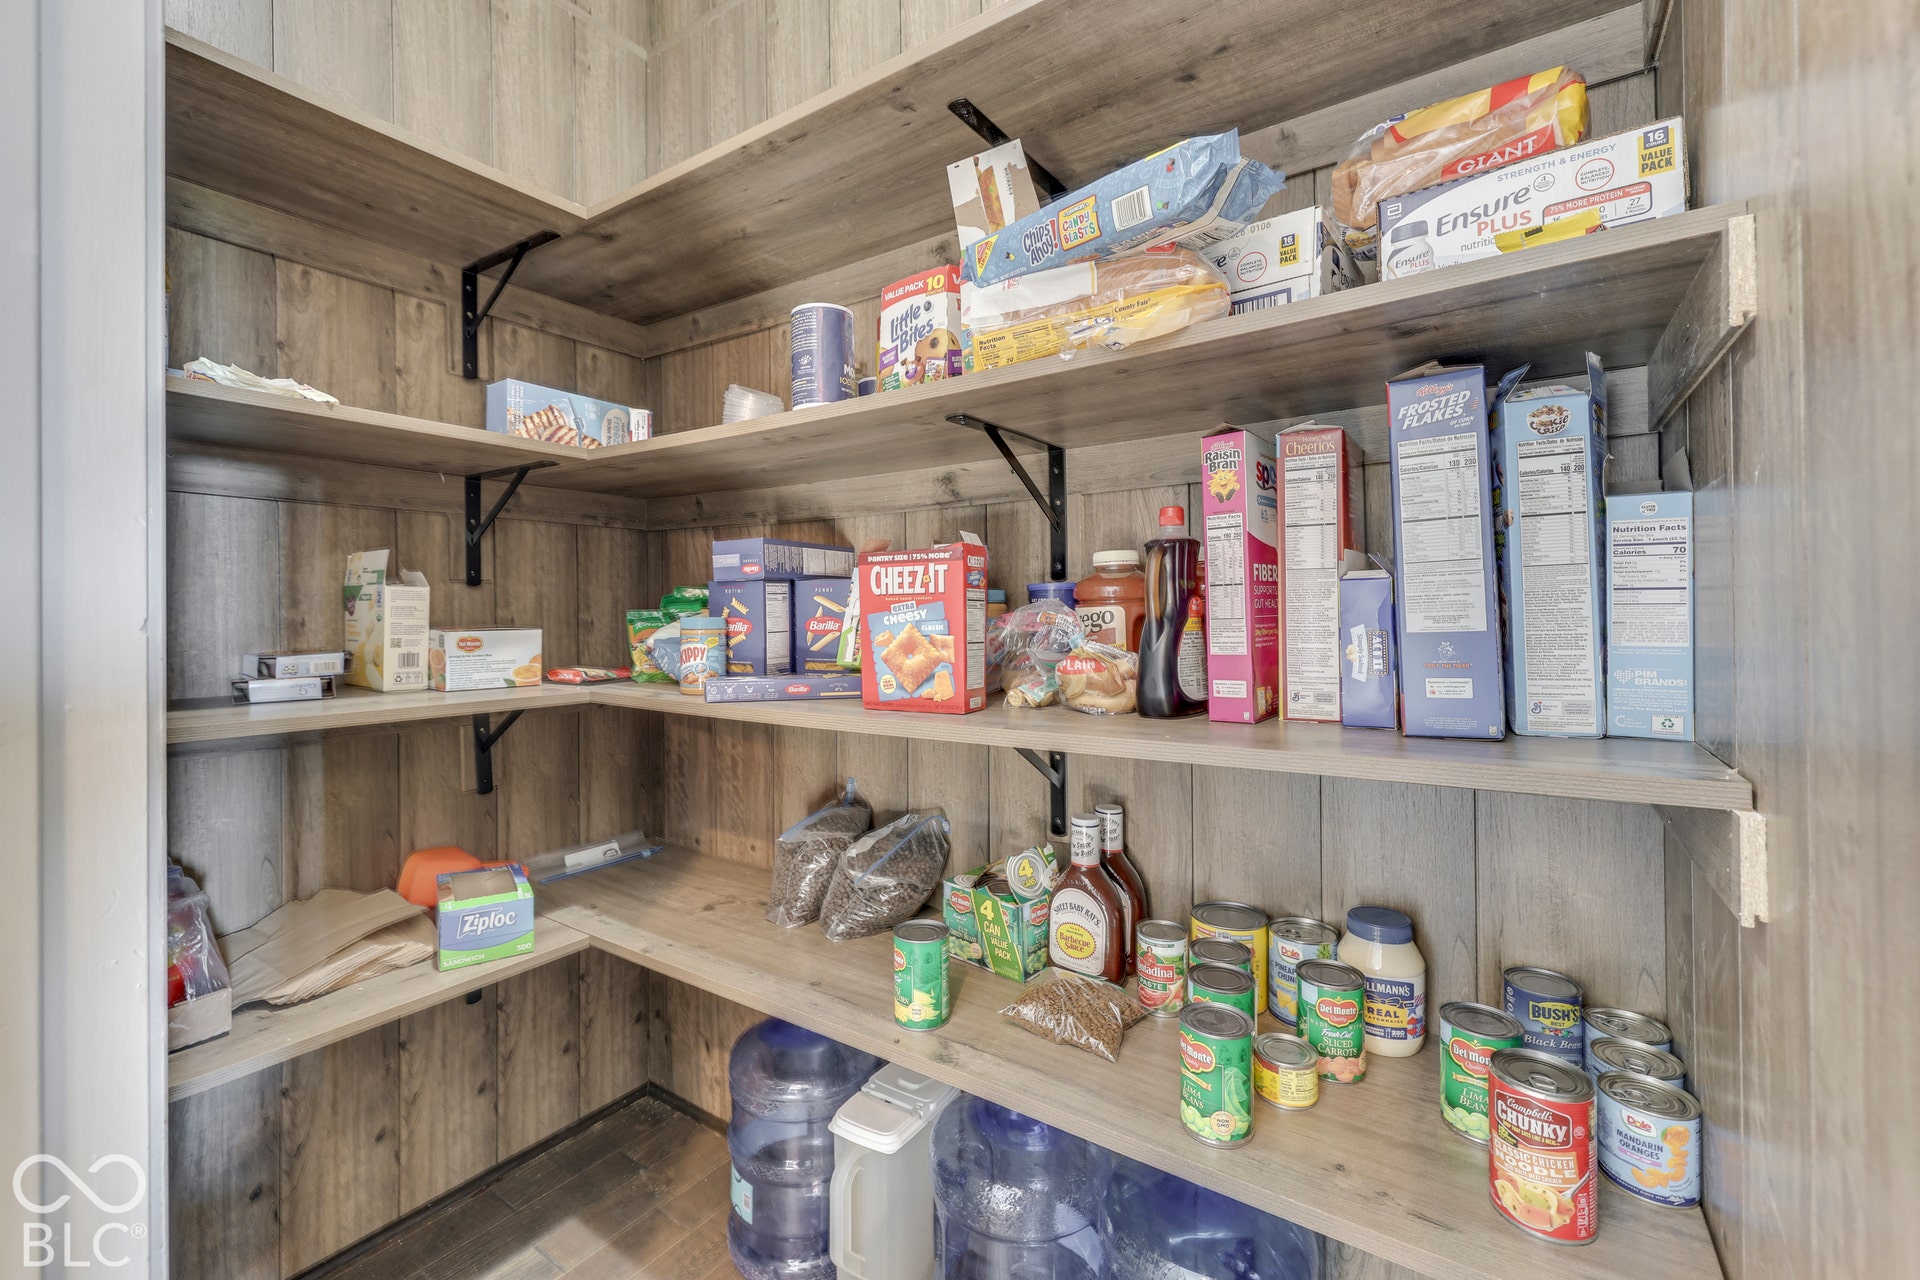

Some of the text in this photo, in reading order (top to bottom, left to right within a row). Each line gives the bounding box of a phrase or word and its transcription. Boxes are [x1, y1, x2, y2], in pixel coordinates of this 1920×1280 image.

[1645, 138, 1668, 148] COUNT
[1647, 130, 1665, 143] 16
[1457, 136, 1538, 174] GIANT
[1641, 147, 1673, 162] VALUE
[1497, 143, 1617, 182] STRENGTH & ENERGY
[1641, 156, 1673, 173] PACK
[1580, 170, 1610, 181] BALANCED
[1550, 190, 1624, 213] 75% MORE PROTEIN
[1630, 196, 1642, 206] 27
[1436, 186, 1532, 237] Ensure
[1250, 221, 1272, 234] 0106
[1477, 210, 1533, 237] PLUS
[1023, 222, 1051, 254] Chips
[1283, 235, 1294, 244] 16
[1280, 247, 1298, 257] VALUE
[1280, 254, 1298, 265] PACK
[1395, 249, 1430, 269] Ensure
[1410, 259, 1430, 269] PLUS
[884, 274, 945, 301] VALUE PACK 10
[1114, 301, 1137, 314] County
[890, 304, 922, 344] Little
[900, 319, 934, 354] Bites
[979, 334, 1006, 346] Nutrition
[979, 342, 997, 352] Facts
[1397, 391, 1471, 420] FROSTED
[1402, 406, 1465, 430] FLAKES
[613, 416, 622, 445] Freez
[1285, 440, 1336, 456] Cheerios
[1205, 449, 1241, 464] Raisin
[1209, 459, 1238, 473] Bran
[1256, 460, 1277, 488] spo
[1613, 525, 1656, 533] Nutrition
[1253, 563, 1279, 582] FIBER
[1253, 585, 1278, 595] SUPPORTS
[1254, 598, 1279, 609] GUT HEAL
[727, 621, 750, 632] arilla
[809, 620, 841, 631] Barilla
[1082, 610, 1115, 633] ego
[1372, 636, 1383, 656] ACT
[680, 646, 706, 665] KIPPY
[1061, 659, 1096, 671] PLAIN
[1634, 670, 1657, 678] PIM
[1634, 678, 1684, 686] BRANDS
[1018, 858, 1034, 878] 4
[1022, 878, 1037, 888] CANS
[980, 900, 995, 921] 4
[1053, 902, 1101, 927] SWEET BABY RAY'S
[462, 910, 516, 935] Ziploc
[983, 921, 1001, 936] CAN
[516, 942, 532, 951] 300
[990, 936, 1008, 950] VALUE
[1059, 931, 1091, 948] Barbecue
[1064, 941, 1085, 953] Sauce
[994, 948, 1012, 962] PACK
[1281, 946, 1300, 959] Dole
[443, 953, 486, 968] SANDWICH
[1275, 962, 1297, 975] PINEAP
[1139, 977, 1163, 991] PASTE
[1277, 971, 1297, 984] CHUN
[1366, 981, 1411, 997] LLMANN'S
[1319, 1003, 1357, 1015] Del Monte
[1367, 1007, 1400, 1018] REAL
[1531, 1004, 1579, 1022] BUSH'S
[1310, 1018, 1328, 1028] MADE
[1321, 1028, 1338, 1037] Fresh
[1323, 1037, 1353, 1047] SLICED
[1524, 1034, 1582, 1050] Black Bean
[1187, 1046, 1212, 1064] Monte
[1317, 1044, 1358, 1057] CARROTS
[1453, 1044, 1490, 1065] Del Mon
[1465, 1061, 1487, 1072] Quality
[1183, 1080, 1201, 1099] LIMA
[1462, 1088, 1489, 1103] LIMA
[1182, 1091, 1205, 1109] BEANS
[1459, 1096, 1489, 1113] BEAN
[1507, 1096, 1554, 1122] Campbell's
[1497, 1099, 1567, 1142] CHUNKY
[1627, 1114, 1652, 1131] Dole
[1511, 1126, 1521, 1134] THAT
[1521, 1130, 1531, 1138] EATS
[1531, 1133, 1541, 1141] LIKE
[1616, 1129, 1664, 1153] MANDARIN
[1495, 1140, 1575, 1169] CLASSIC CHICKEN
[1619, 1138, 1660, 1160] ORANGES
[1495, 1150, 1577, 1179] NOODLE
[1528, 1171, 1542, 1180] MEAT
[1543, 1176, 1562, 1184] CHICKEN
